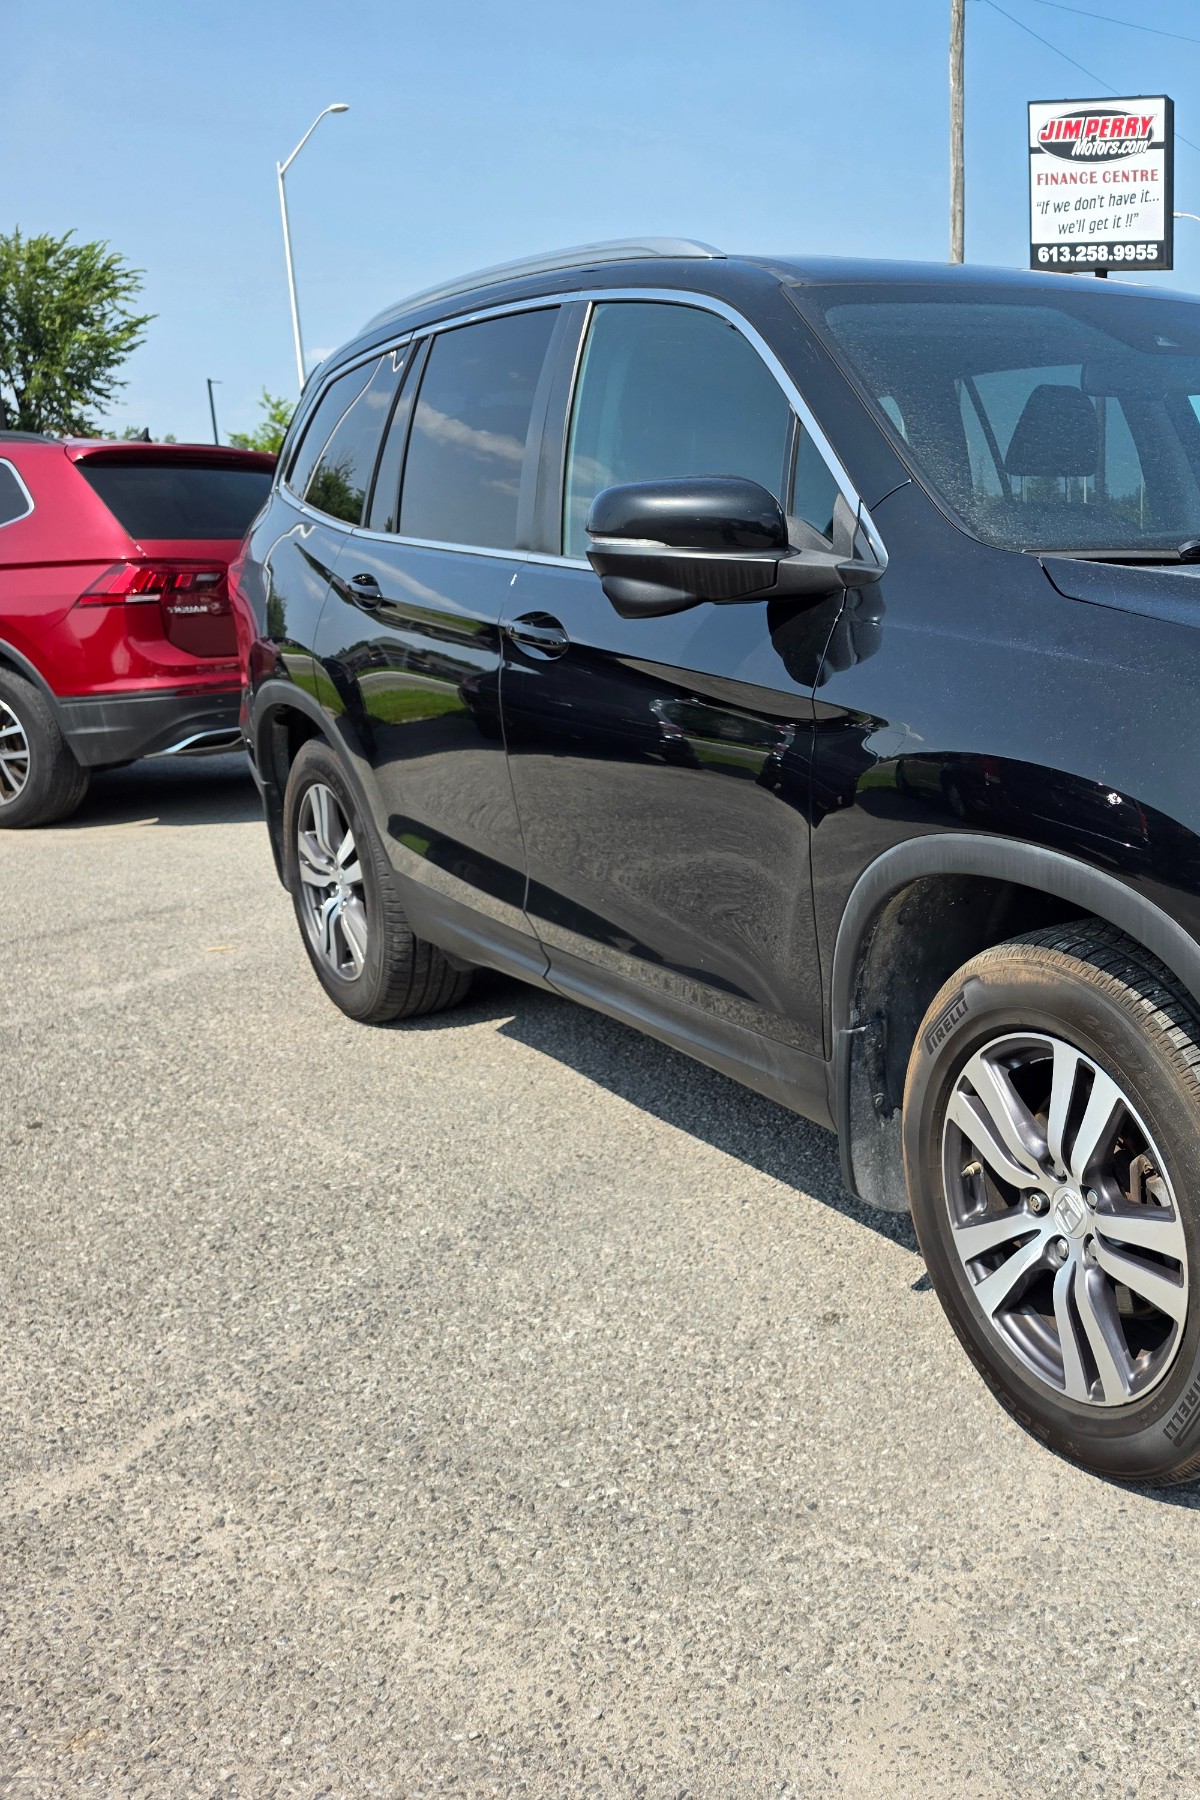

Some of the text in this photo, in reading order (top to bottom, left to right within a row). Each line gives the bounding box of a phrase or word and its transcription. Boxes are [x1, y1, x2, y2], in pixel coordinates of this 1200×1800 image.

[1040, 115, 1155, 141] JIM PERRY
[1072, 138, 1149, 157] Motors.com
[1037, 169, 1159, 186] FINANCE CENTRE
[1053, 201, 1071, 213] we
[1074, 195, 1105, 211] don't
[1108, 193, 1137, 207] have
[1140, 189, 1160, 203] it...
[1058, 218, 1086, 235] we'll
[1089, 218, 1109, 234] get
[1112, 215, 1122, 229] it
[1037, 243, 1158, 263] 613.258.9955
[924, 990, 969, 1055] PIRELLI
